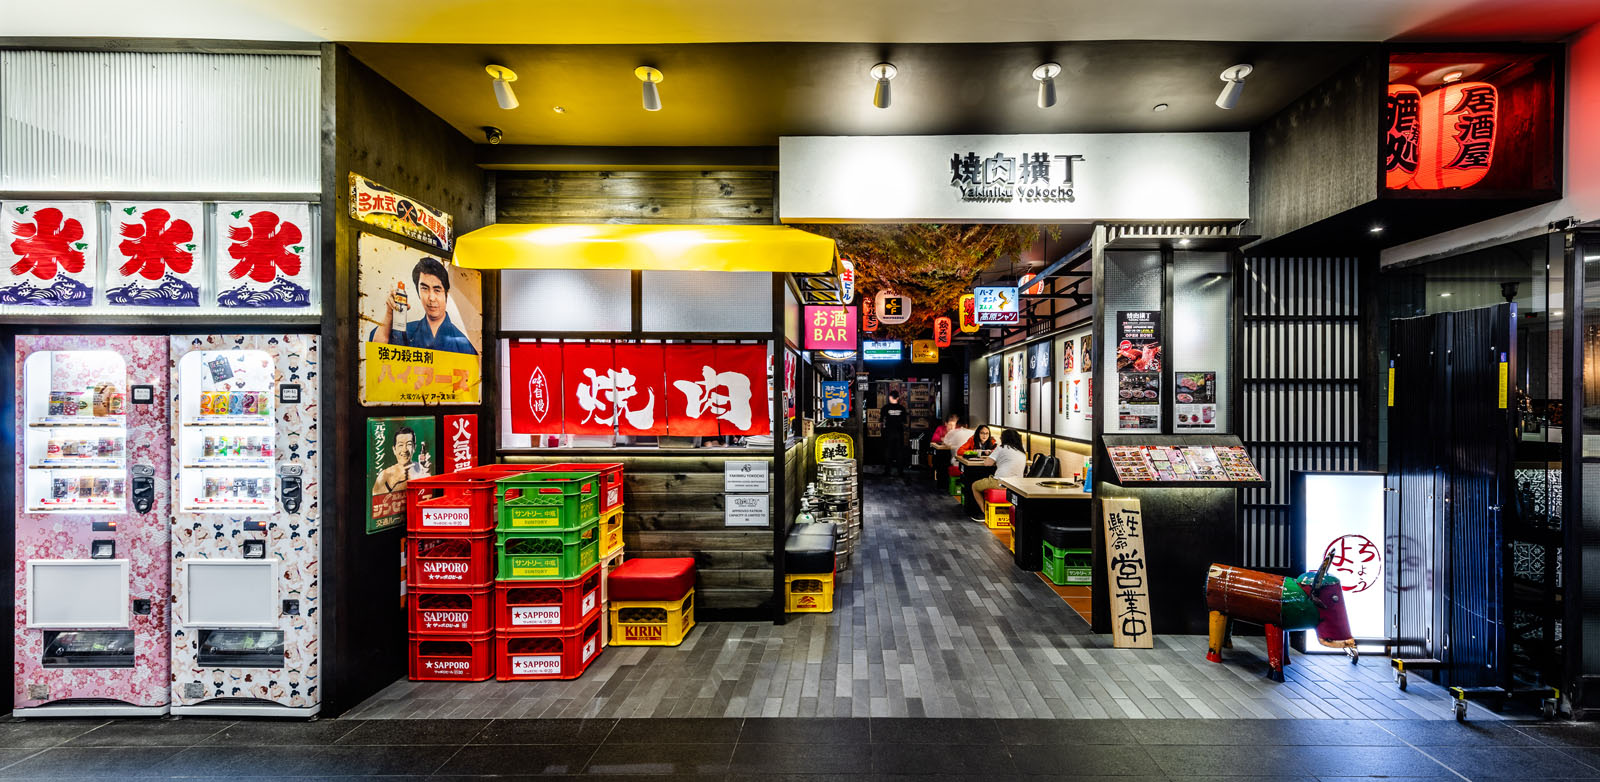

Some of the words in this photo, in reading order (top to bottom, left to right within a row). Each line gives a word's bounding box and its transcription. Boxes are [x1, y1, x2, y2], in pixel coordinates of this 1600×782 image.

[1442, 86, 1496, 170] 居酒屋
[950, 152, 1084, 185] 焼肉横丁
[960, 186, 1013, 198] Yakiniku
[1017, 186, 1074, 198] Yokocho
[842, 268, 853, 300] 生ビール
[813, 310, 847, 328] お酒
[980, 312, 1017, 321] 高原シャツ
[813, 328, 848, 342] BAR
[378, 346, 434, 364] 強力殺虫剤
[377, 364, 470, 392] ハイアース
[532, 374, 545, 414] 味自慢
[575, 365, 752, 431] 焼肉
[825, 391, 848, 399] ビール
[433, 512, 469, 520] SAPPORO
[514, 509, 543, 517] サントリー
[423, 562, 469, 573] SAPPORO
[1110, 549, 1147, 643] 営業中
[423, 611, 469, 622] SAPPORO
[522, 610, 559, 618] SAPPORO
[625, 626, 662, 636] KIRIN
[433, 661, 470, 669] SAPPORO
[523, 660, 560, 668] SAPPORO
